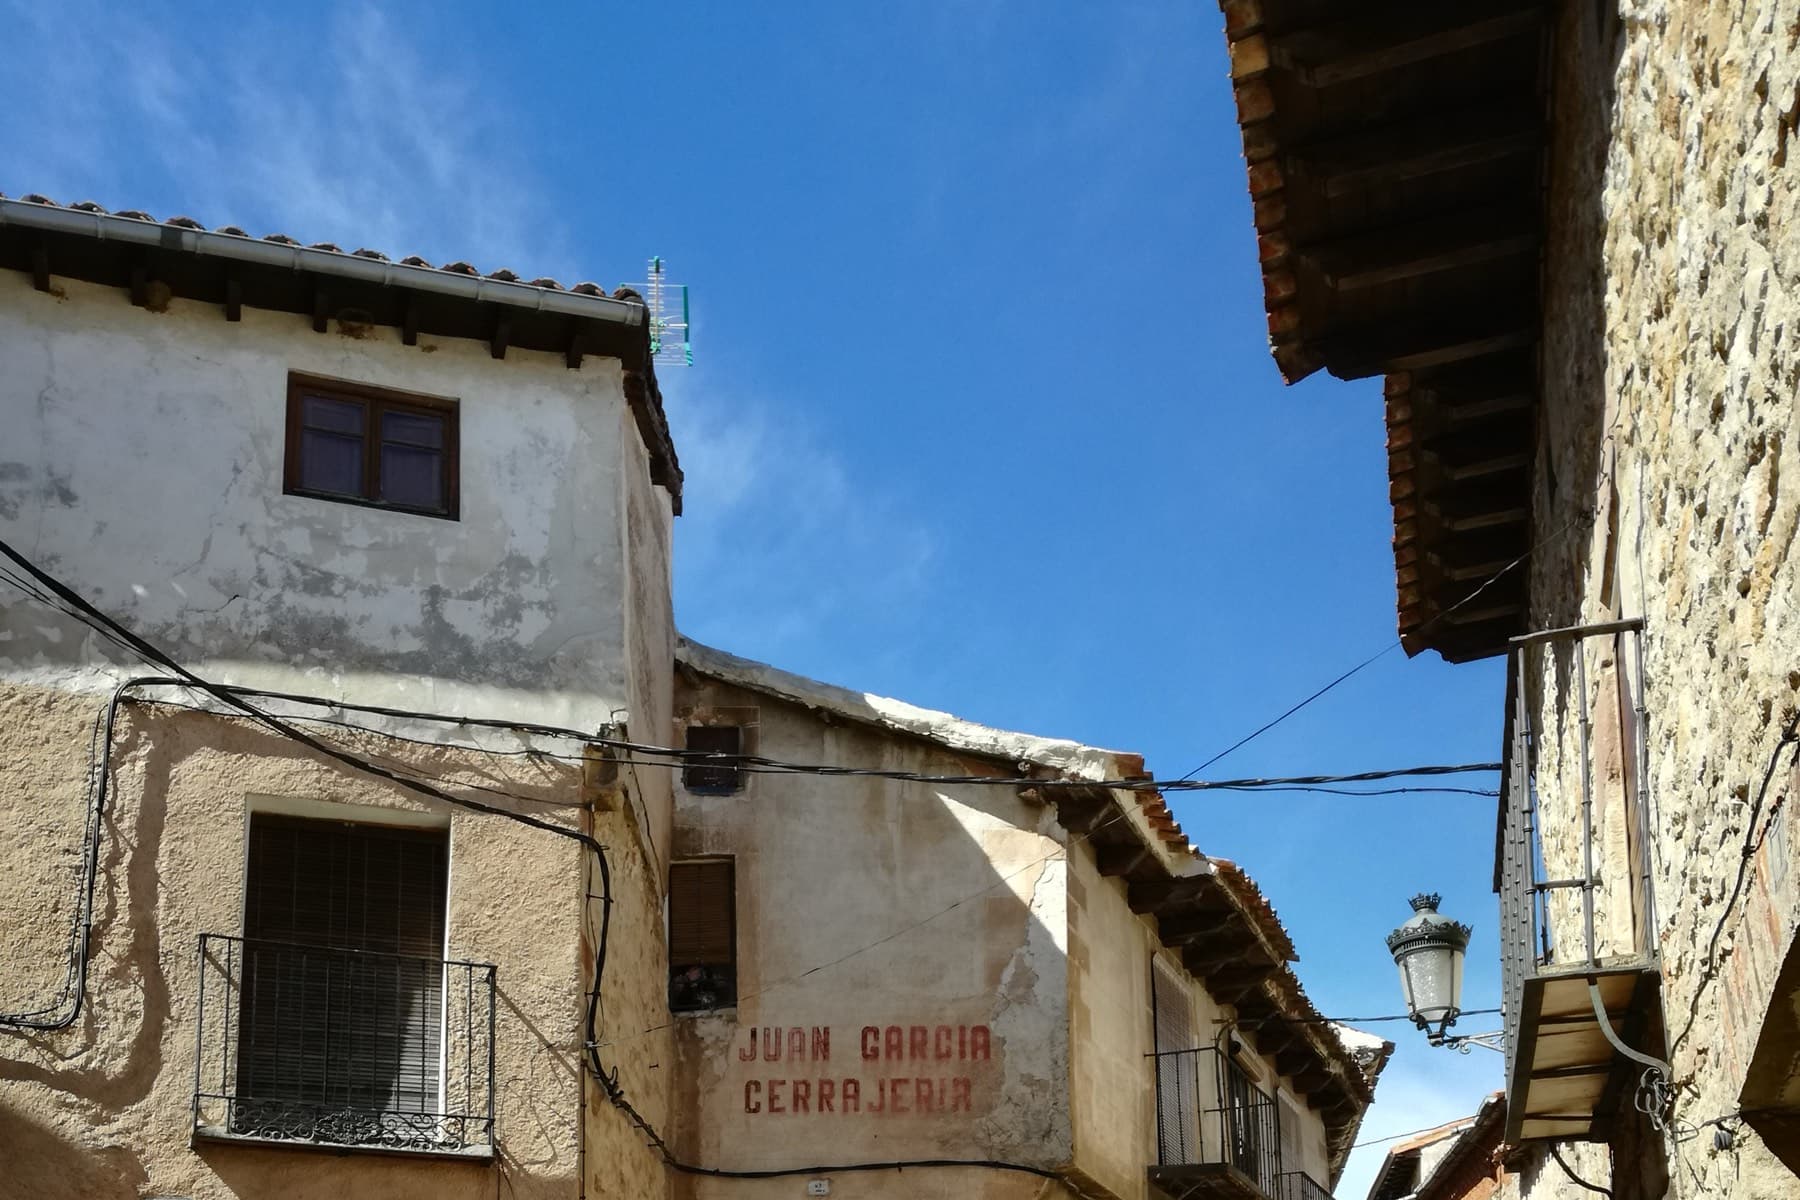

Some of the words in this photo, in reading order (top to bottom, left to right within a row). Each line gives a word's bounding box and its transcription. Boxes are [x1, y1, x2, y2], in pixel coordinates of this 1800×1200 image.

[739, 1026, 831, 1062] JUAN
[861, 1024, 992, 1061] GARCIA
[744, 1077, 972, 1114] CERRAJERIA
